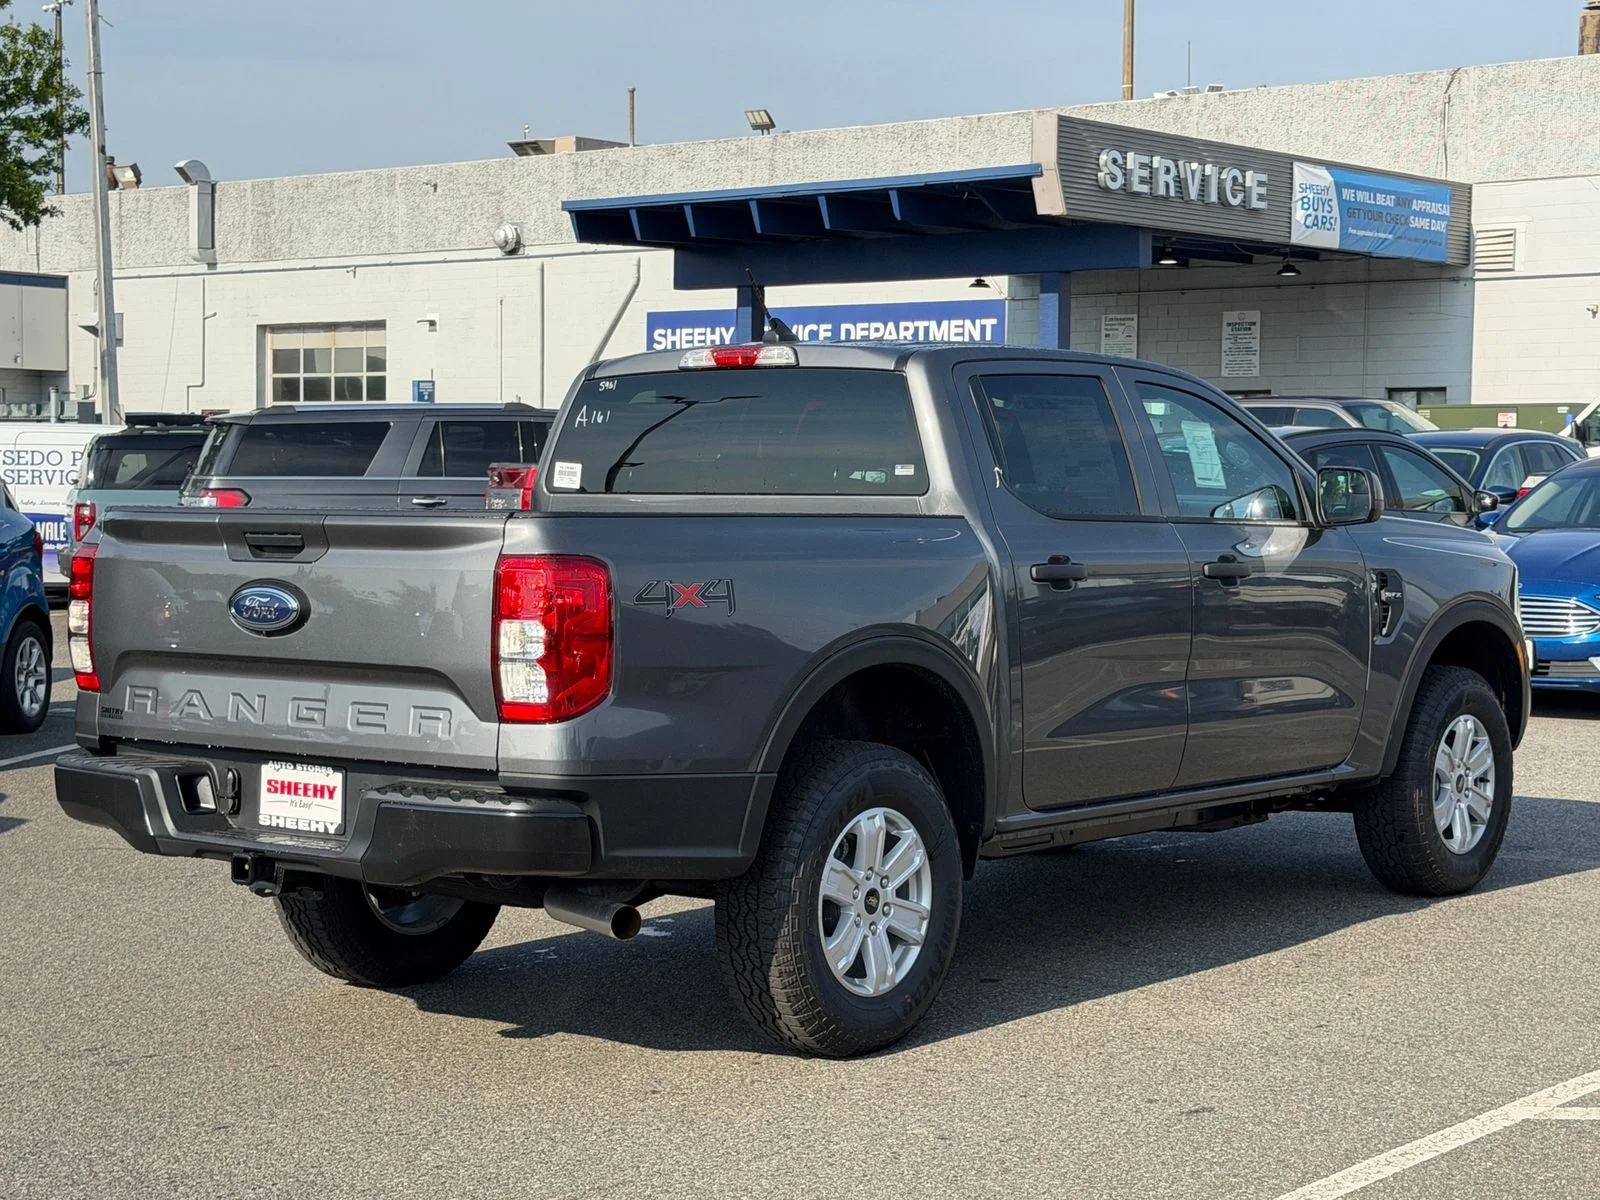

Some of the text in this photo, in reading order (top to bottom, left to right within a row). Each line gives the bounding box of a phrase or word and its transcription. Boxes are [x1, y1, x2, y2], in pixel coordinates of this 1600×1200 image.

[1098, 148, 1268, 210] SERVICE
[1298, 182, 1331, 197] SHEEHY
[1301, 195, 1333, 215] BUYS
[1341, 187, 1355, 201] WE
[1355, 189, 1375, 204] WILL
[1376, 192, 1395, 207] BEAT
[1304, 213, 1337, 232] CARS!
[1347, 207, 1361, 219] GET
[1361, 208, 1384, 222] YOUR
[1409, 215, 1430, 230] SAME
[652, 326, 736, 350] SHEEHY
[840, 318, 998, 342] DEPARTMENT
[0, 449, 63, 467] SEDO
[241, 595, 279, 620] Ford
[124, 684, 453, 738] RANGER
[267, 760, 334, 775] AUTO STORES
[266, 778, 338, 801] SHEEHY
[289, 798, 314, 811] It's Easy!
[258, 813, 340, 835] SHEEHY
